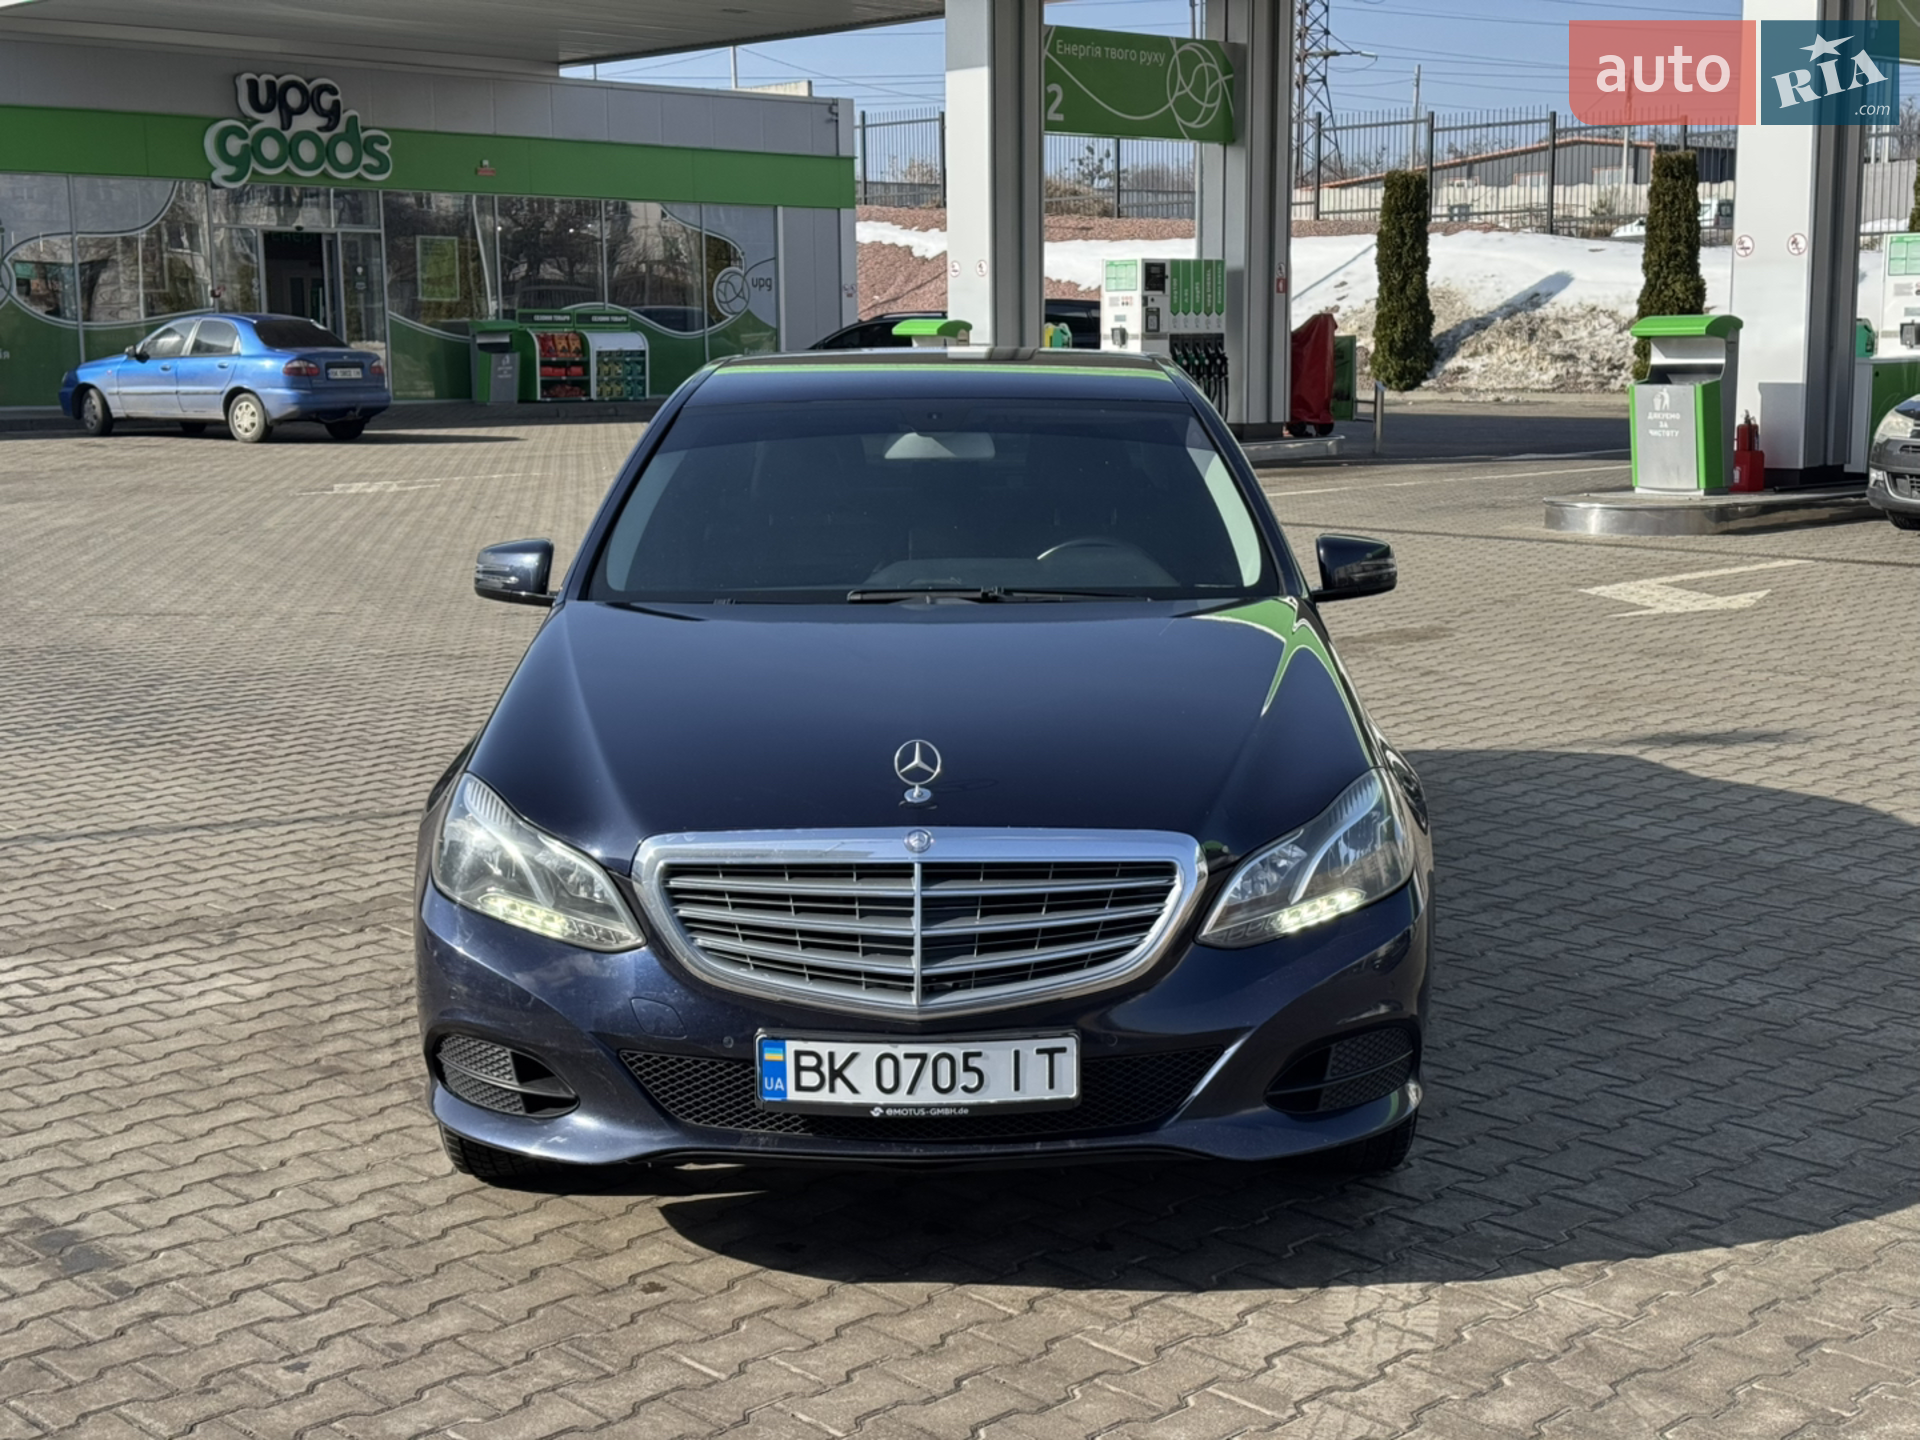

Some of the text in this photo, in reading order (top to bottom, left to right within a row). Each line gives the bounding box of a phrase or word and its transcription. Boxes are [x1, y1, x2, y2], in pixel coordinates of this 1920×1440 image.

[1056, 39, 1166, 67] Енергія твого руху
[246, 78, 341, 132] upg
[1046, 83, 1064, 121] 2
[214, 115, 392, 182] goods
[751, 277, 772, 291] upg
[765, 1077, 784, 1091] UA
[793, 1050, 860, 1094] BK
[874, 1051, 985, 1095] 0705
